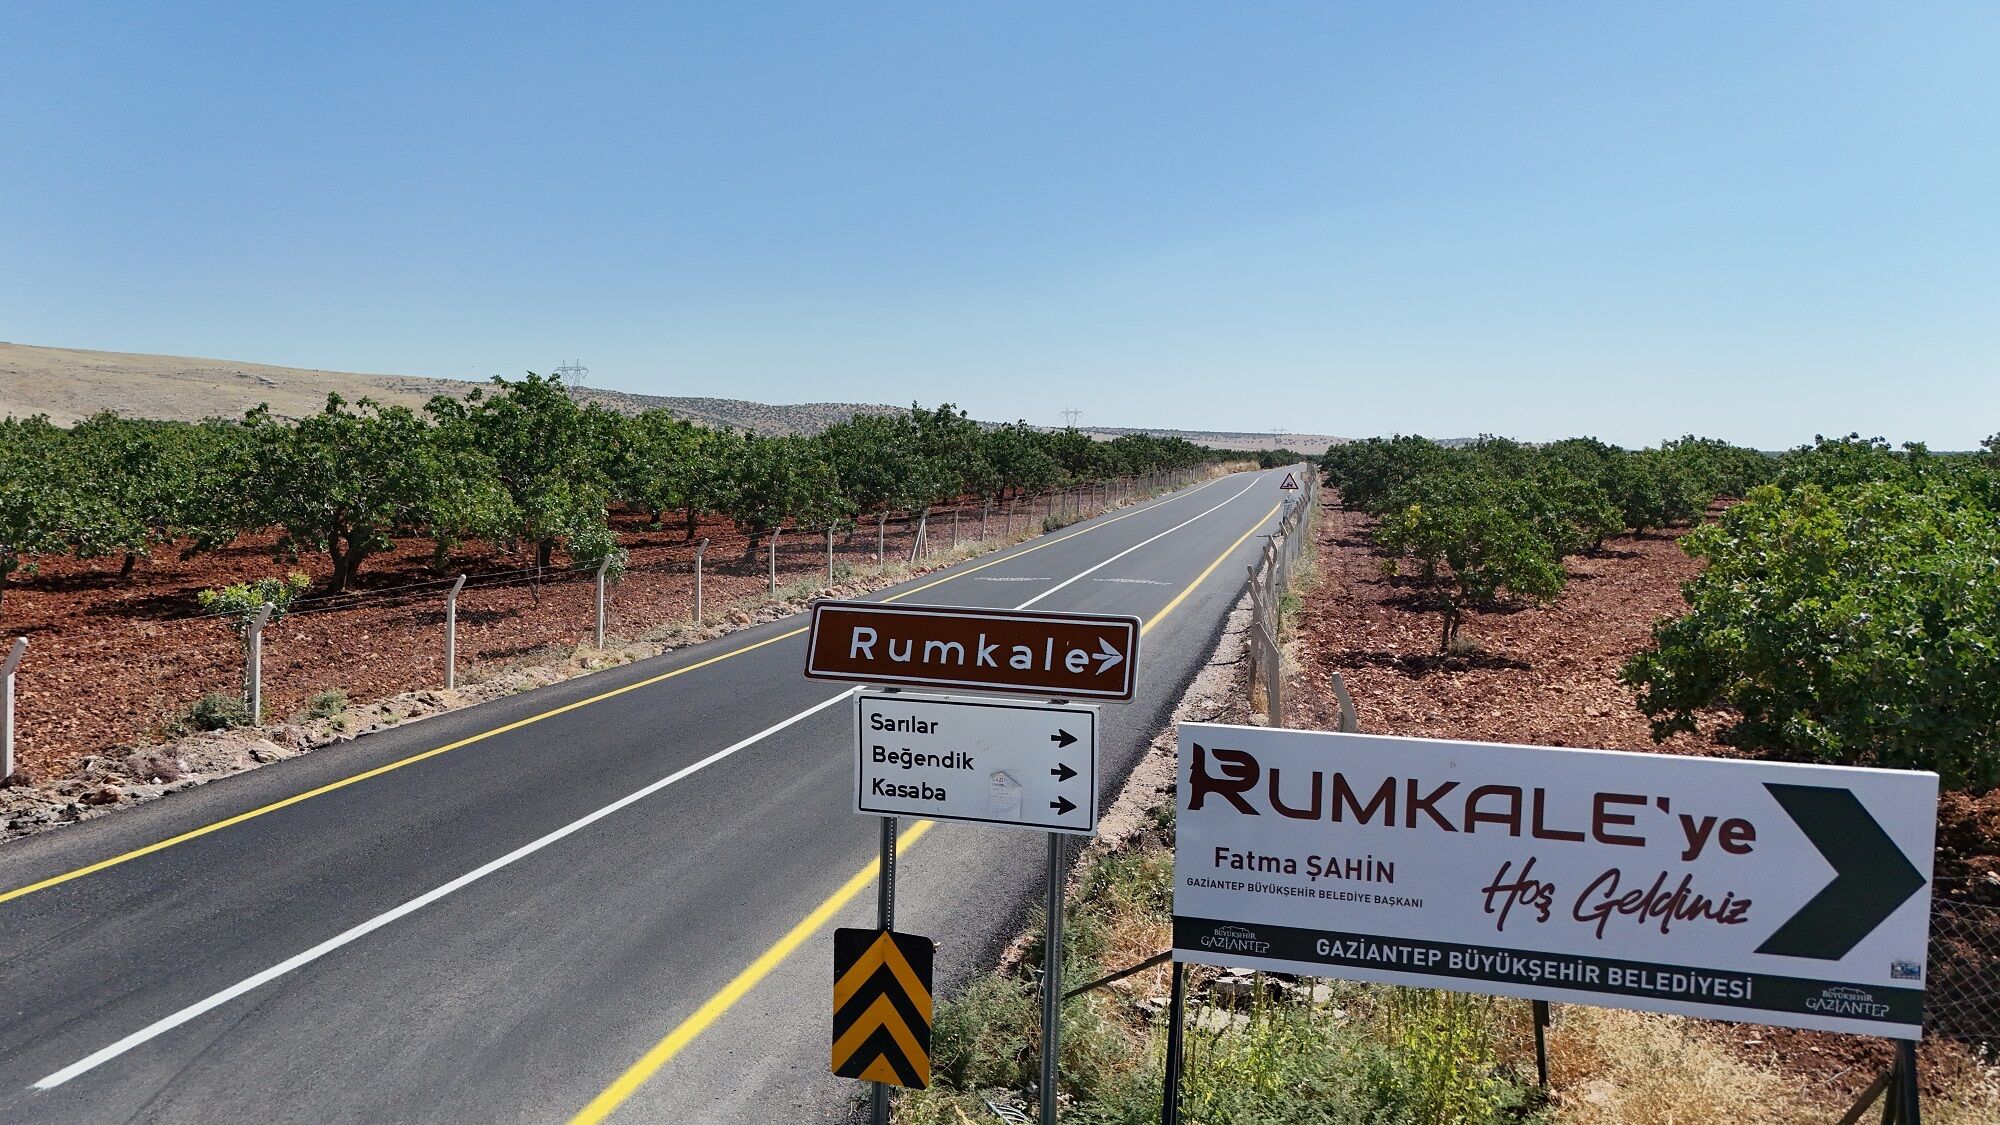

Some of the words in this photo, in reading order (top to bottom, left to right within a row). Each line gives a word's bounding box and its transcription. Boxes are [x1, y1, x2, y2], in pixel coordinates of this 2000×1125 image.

[849, 626, 1090, 674] Rumkale
[870, 713, 938, 735] Sarılar
[872, 746, 975, 770] Beğendik
[872, 778, 946, 802] Kasaba
[1187, 742, 1756, 861] RUMKALE'ye
[1214, 847, 1297, 875] Fatma
[1306, 854, 1395, 884] ŞAHİN
[1186, 877, 1245, 891] GAZİANTEP
[1247, 882, 1316, 898] BÜYÜKŞEHİR
[1318, 890, 1371, 903] BELEDİYE
[1374, 895, 1423, 908] BAŞKANI
[1482, 856, 1555, 933] Hoş
[1573, 868, 1752, 939] Geldiniz
[1316, 938, 1442, 967] GAZİANTEP
[1449, 949, 1599, 984] BÜYÜKŞEHİR
[1607, 968, 1753, 1000] BELEDİYESİ
